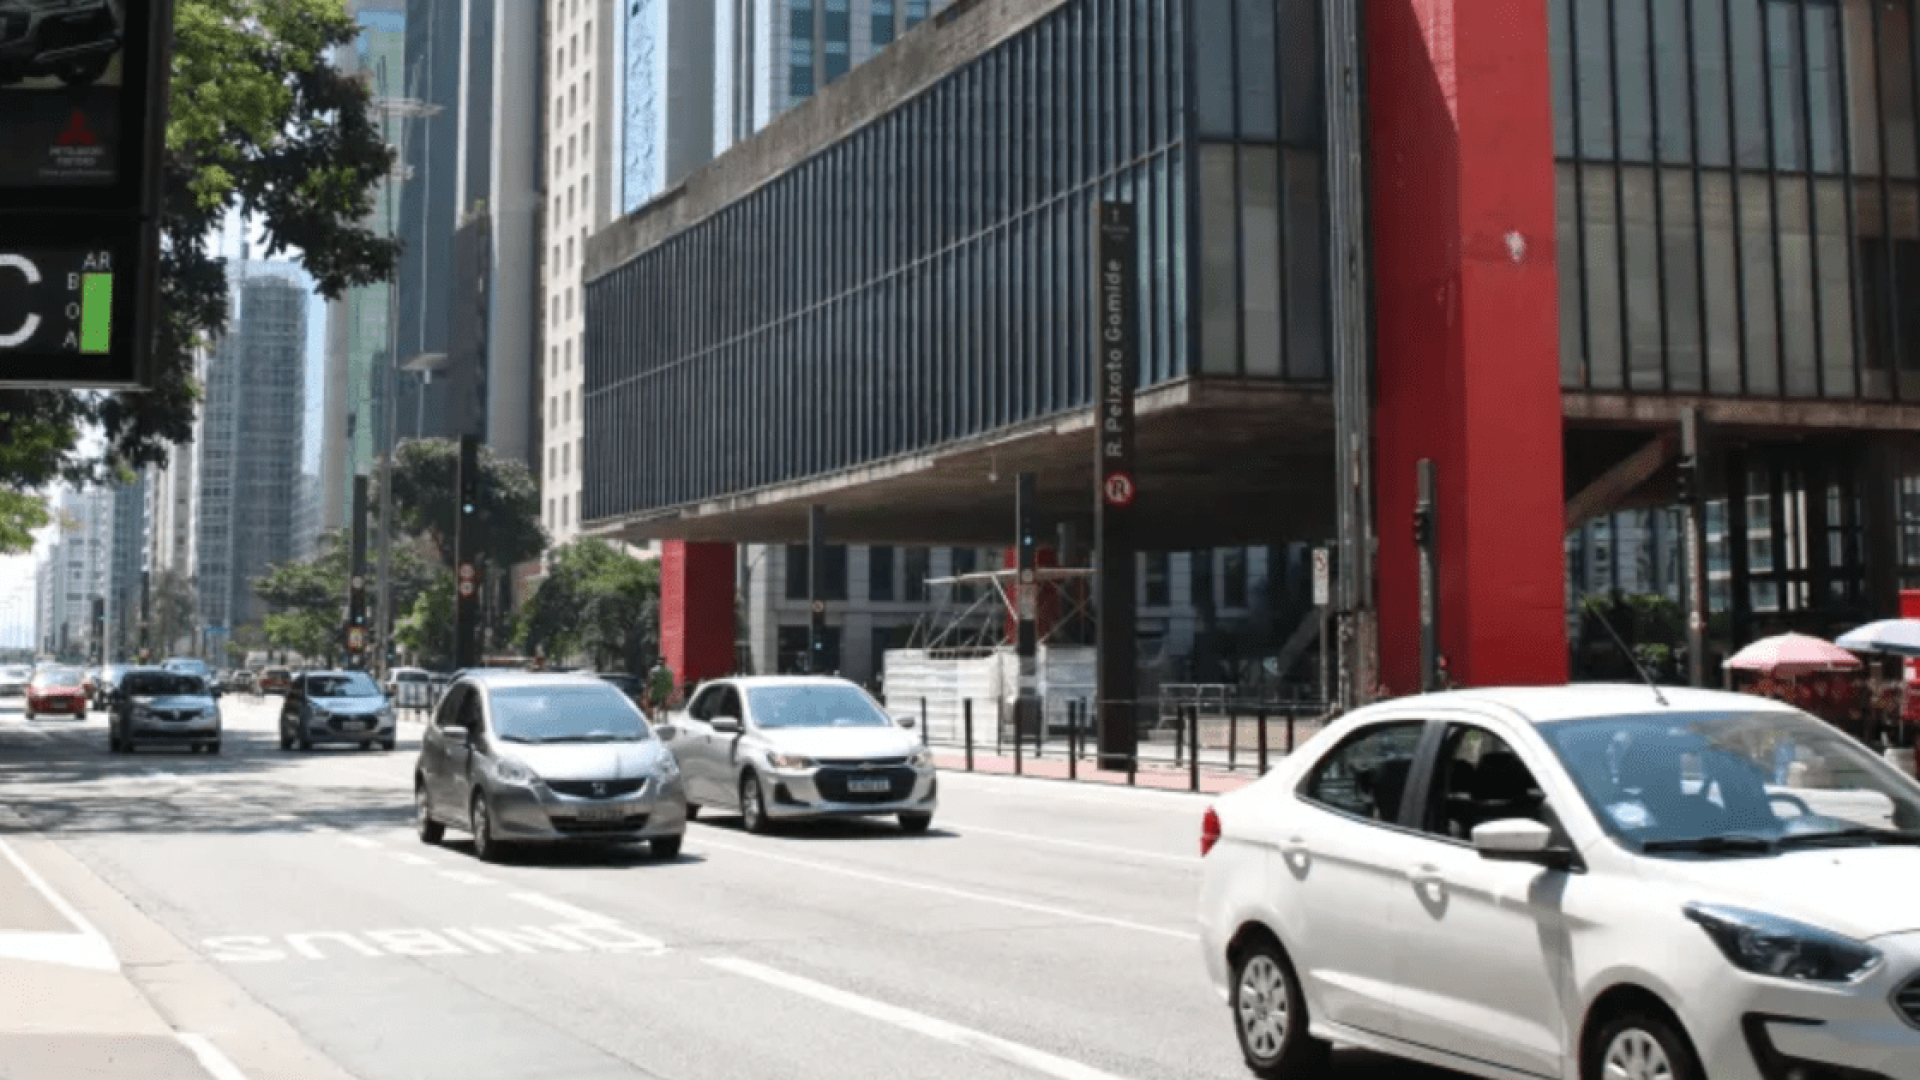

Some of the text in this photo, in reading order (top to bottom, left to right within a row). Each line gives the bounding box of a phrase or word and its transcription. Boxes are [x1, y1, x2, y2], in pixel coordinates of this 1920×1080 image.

[82, 250, 111, 270] AR
[1104, 258, 1122, 342] Gomide
[1104, 348, 1122, 433] Peixoto
